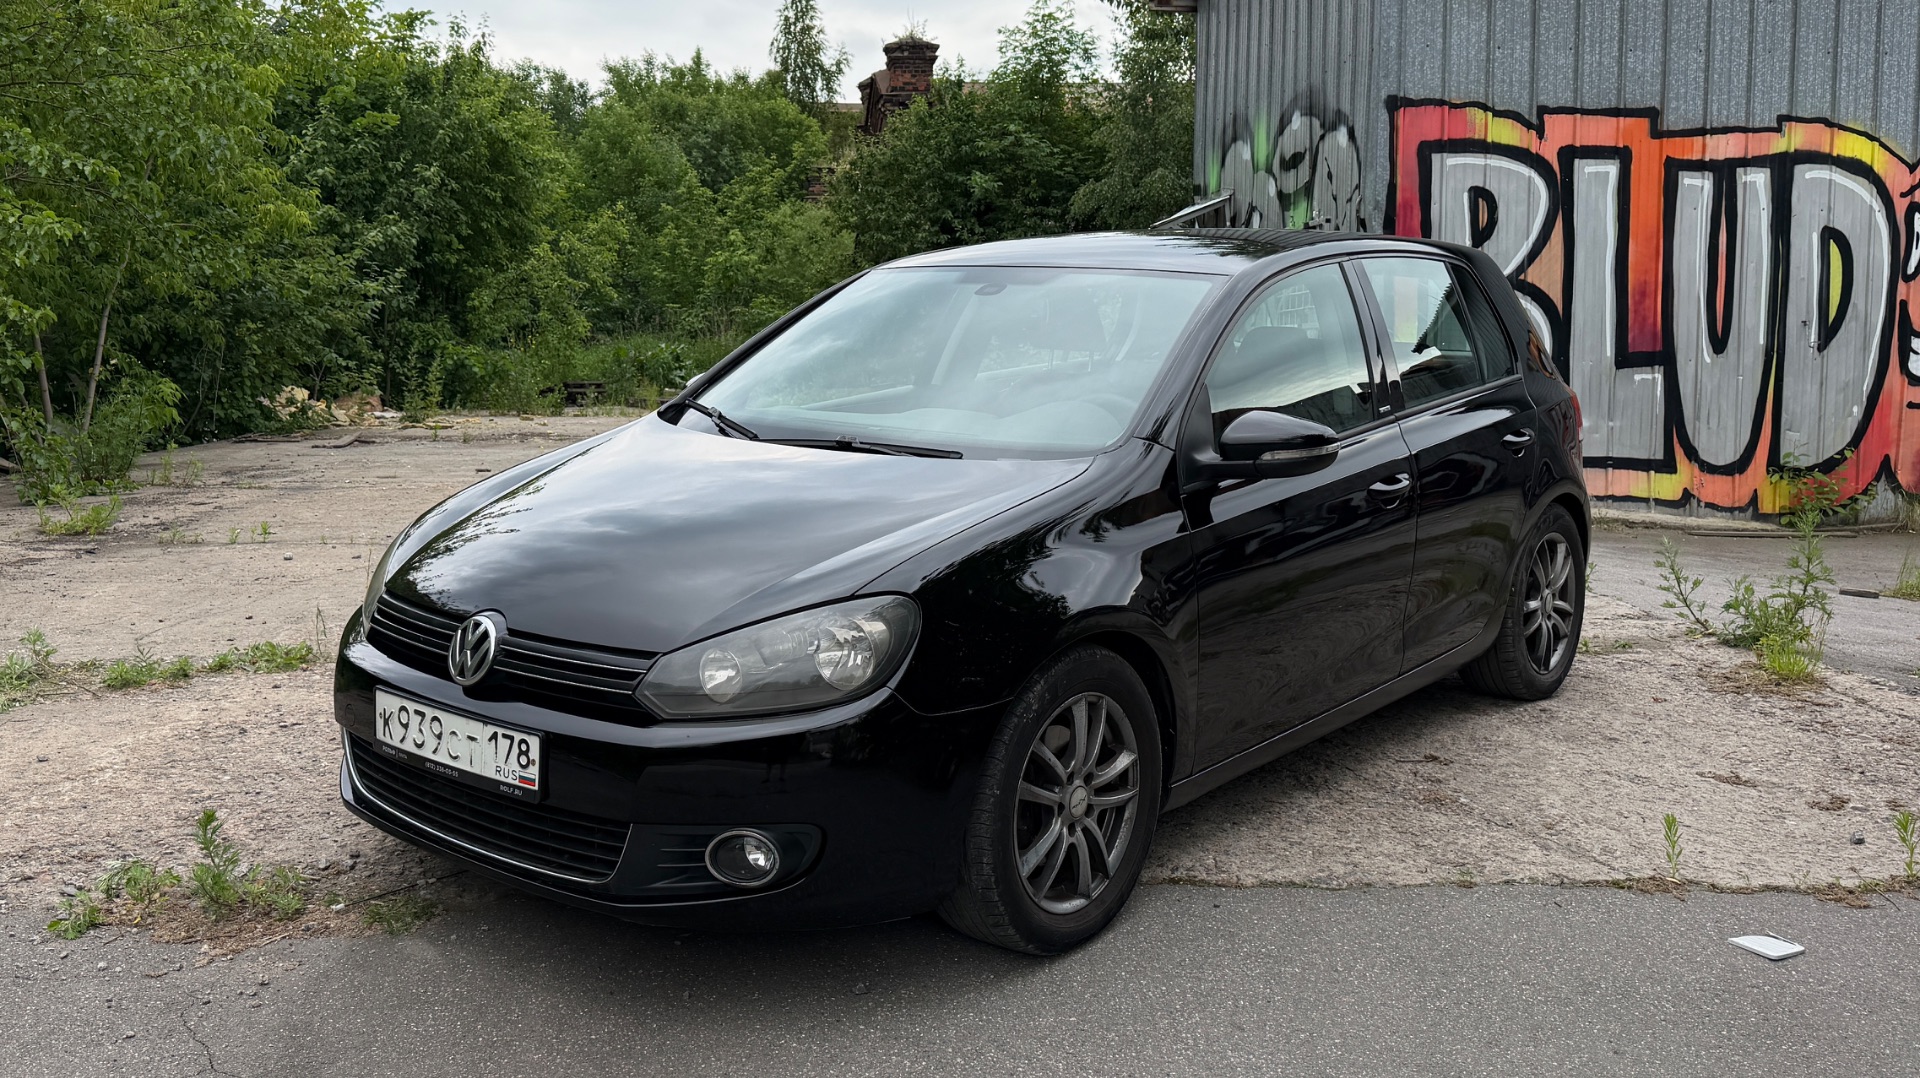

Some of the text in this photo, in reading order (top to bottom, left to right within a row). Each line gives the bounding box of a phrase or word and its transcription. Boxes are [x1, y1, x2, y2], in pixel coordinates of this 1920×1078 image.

[1417, 138, 1899, 474] BLUD
[488, 730, 531, 769] 178
[495, 765, 518, 781] RUS
